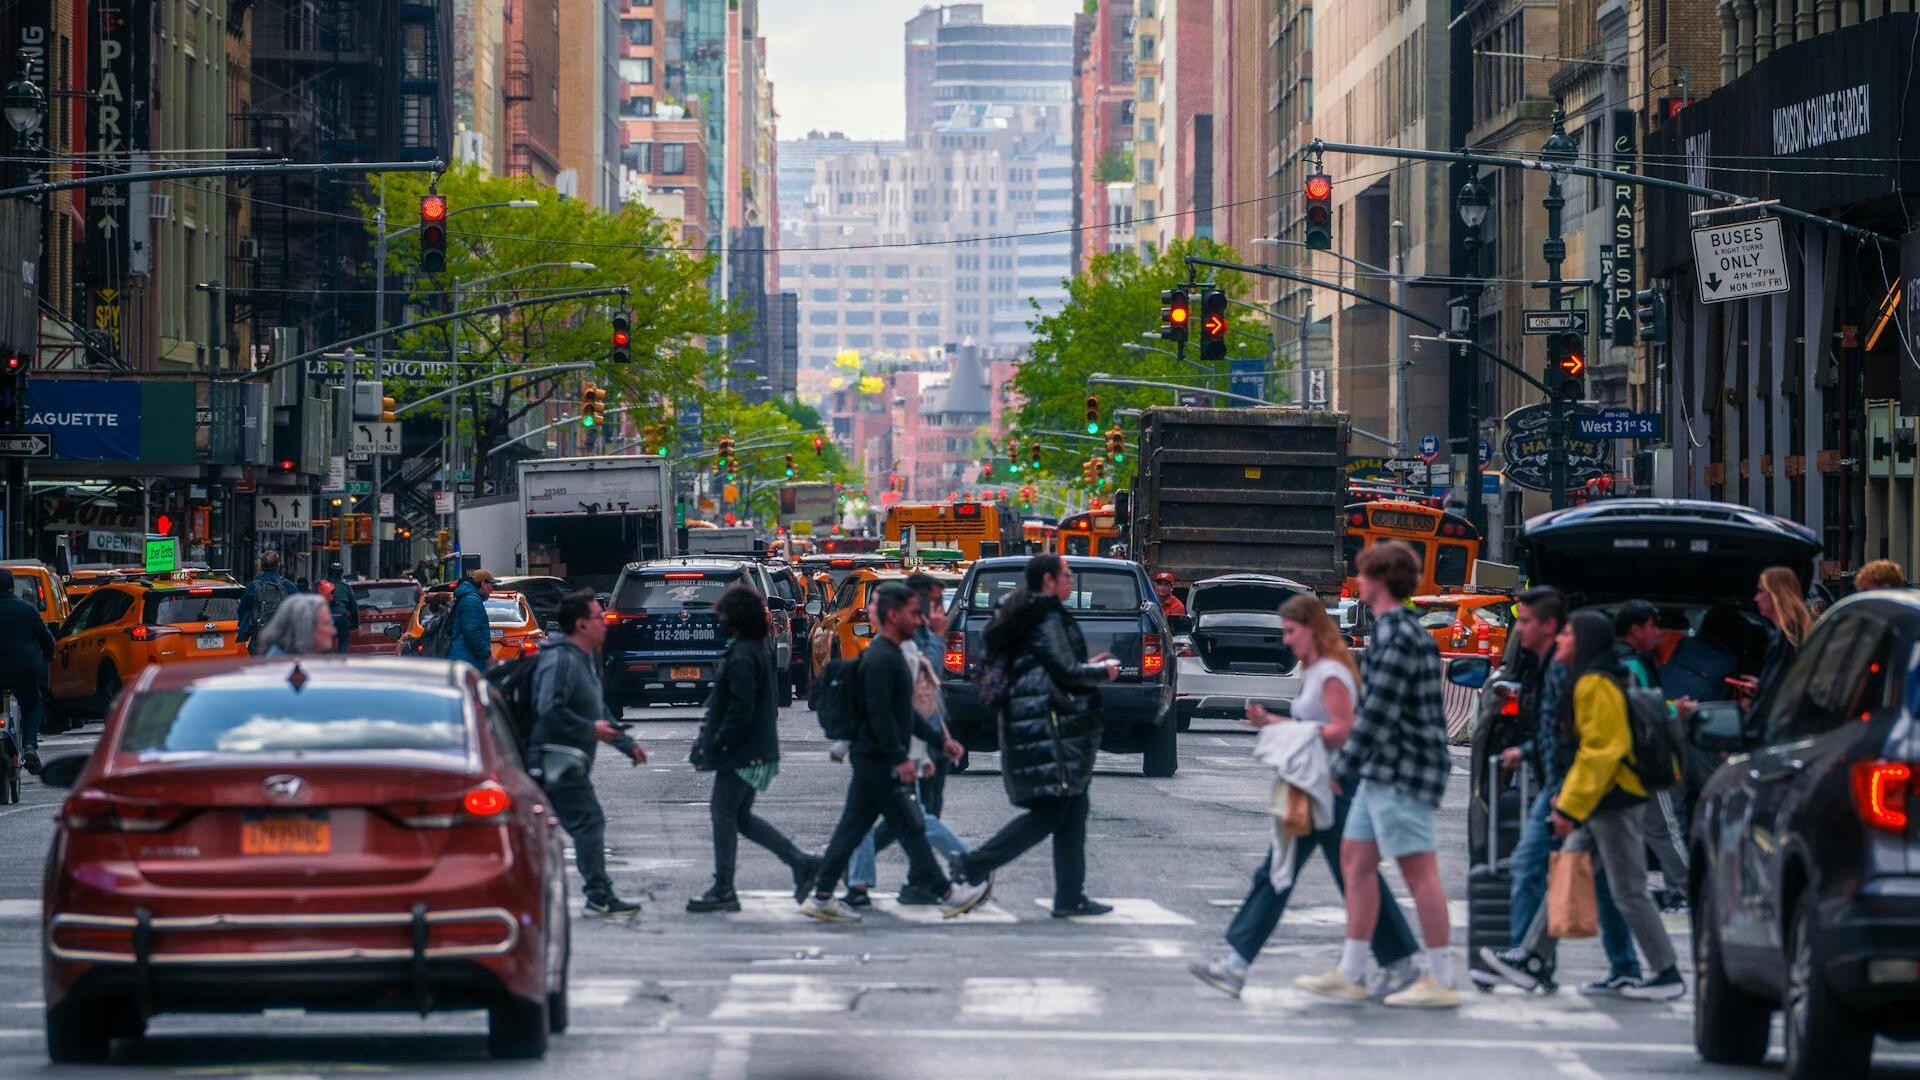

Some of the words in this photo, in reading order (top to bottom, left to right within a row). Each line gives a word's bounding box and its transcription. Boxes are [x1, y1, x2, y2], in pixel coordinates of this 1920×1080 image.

[100, 39, 123, 167] PARK
[1773, 101, 1806, 156] MADISON
[1806, 92, 1838, 149] SQUARE
[1838, 83, 1870, 139] GARDEN
[1616, 165, 1632, 258] ERASE
[1711, 228, 1763, 247] BUSES
[1721, 246, 1740, 255] RIGHT
[1742, 243, 1764, 252] TURNS
[1720, 252, 1760, 271] ONLY
[1734, 268, 1776, 281] 4PM-7PM
[1729, 283, 1748, 293] MON
[1751, 280, 1766, 288] THRU
[1768, 277, 1782, 287] FRI
[1616, 268, 1631, 320] SPA
[96, 305, 120, 328] SPY
[1535, 318, 1551, 327] ONE
[307, 360, 328, 374] LE
[1580, 420, 1612, 433] West
[1615, 420, 1636, 433] 31st
[1639, 420, 1653, 433] St
[20, 440, 40, 450] WAY
[355, 444, 374, 452] ONLY
[380, 444, 398, 452] ONLY
[350, 482, 361, 492] 30
[258, 520, 280, 529] ONLY
[285, 520, 307, 529] ONLY
[97, 534, 132, 550] OPEN!
